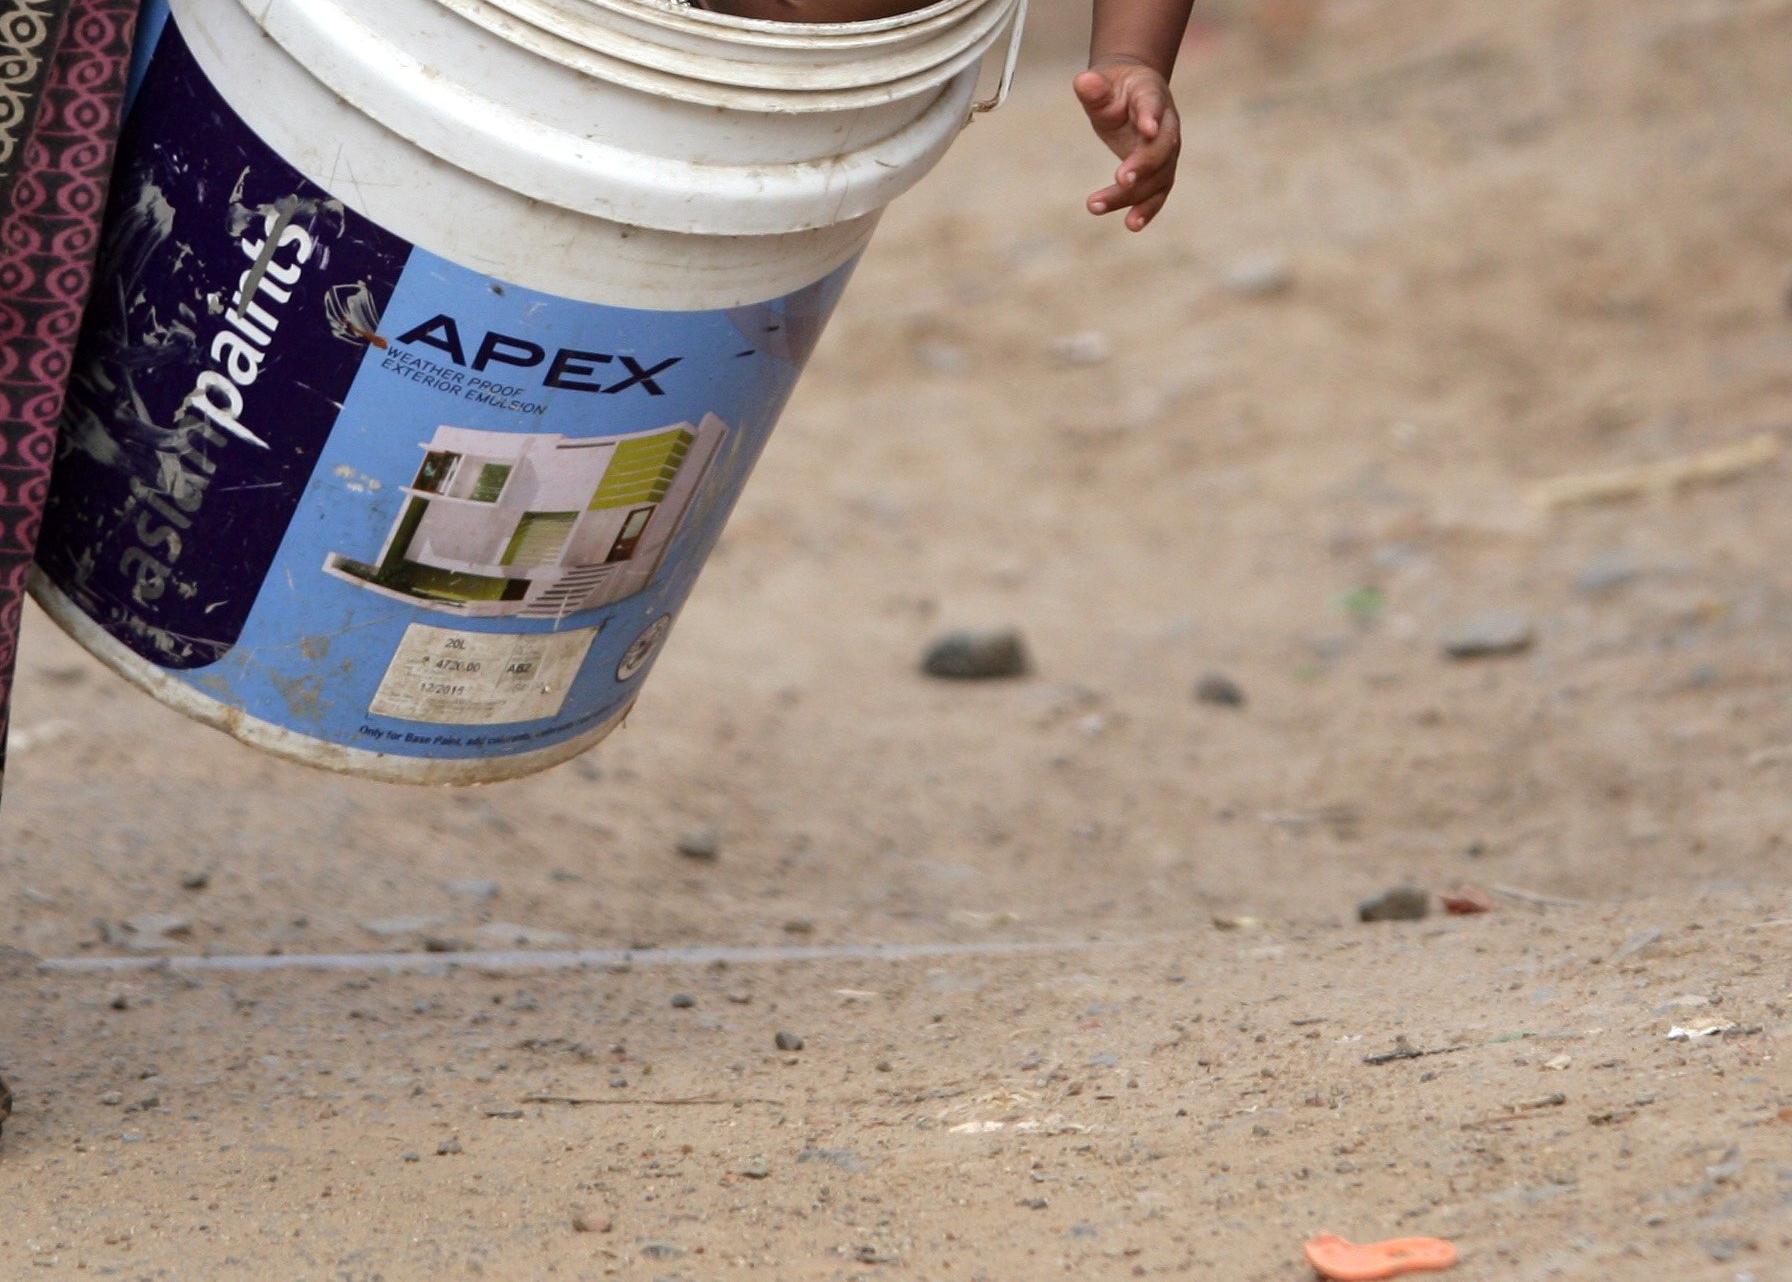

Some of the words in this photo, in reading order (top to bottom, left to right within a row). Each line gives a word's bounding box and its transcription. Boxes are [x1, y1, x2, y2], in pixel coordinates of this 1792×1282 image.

[187, 208, 311, 450] paints
[395, 313, 684, 396] APEX
[381, 358, 463, 396] EXTERIOR
[464, 389, 548, 415] EMULSION
[387, 346, 465, 383] WEATHER
[467, 377, 525, 398] PROOF
[359, 725, 383, 739] Only
